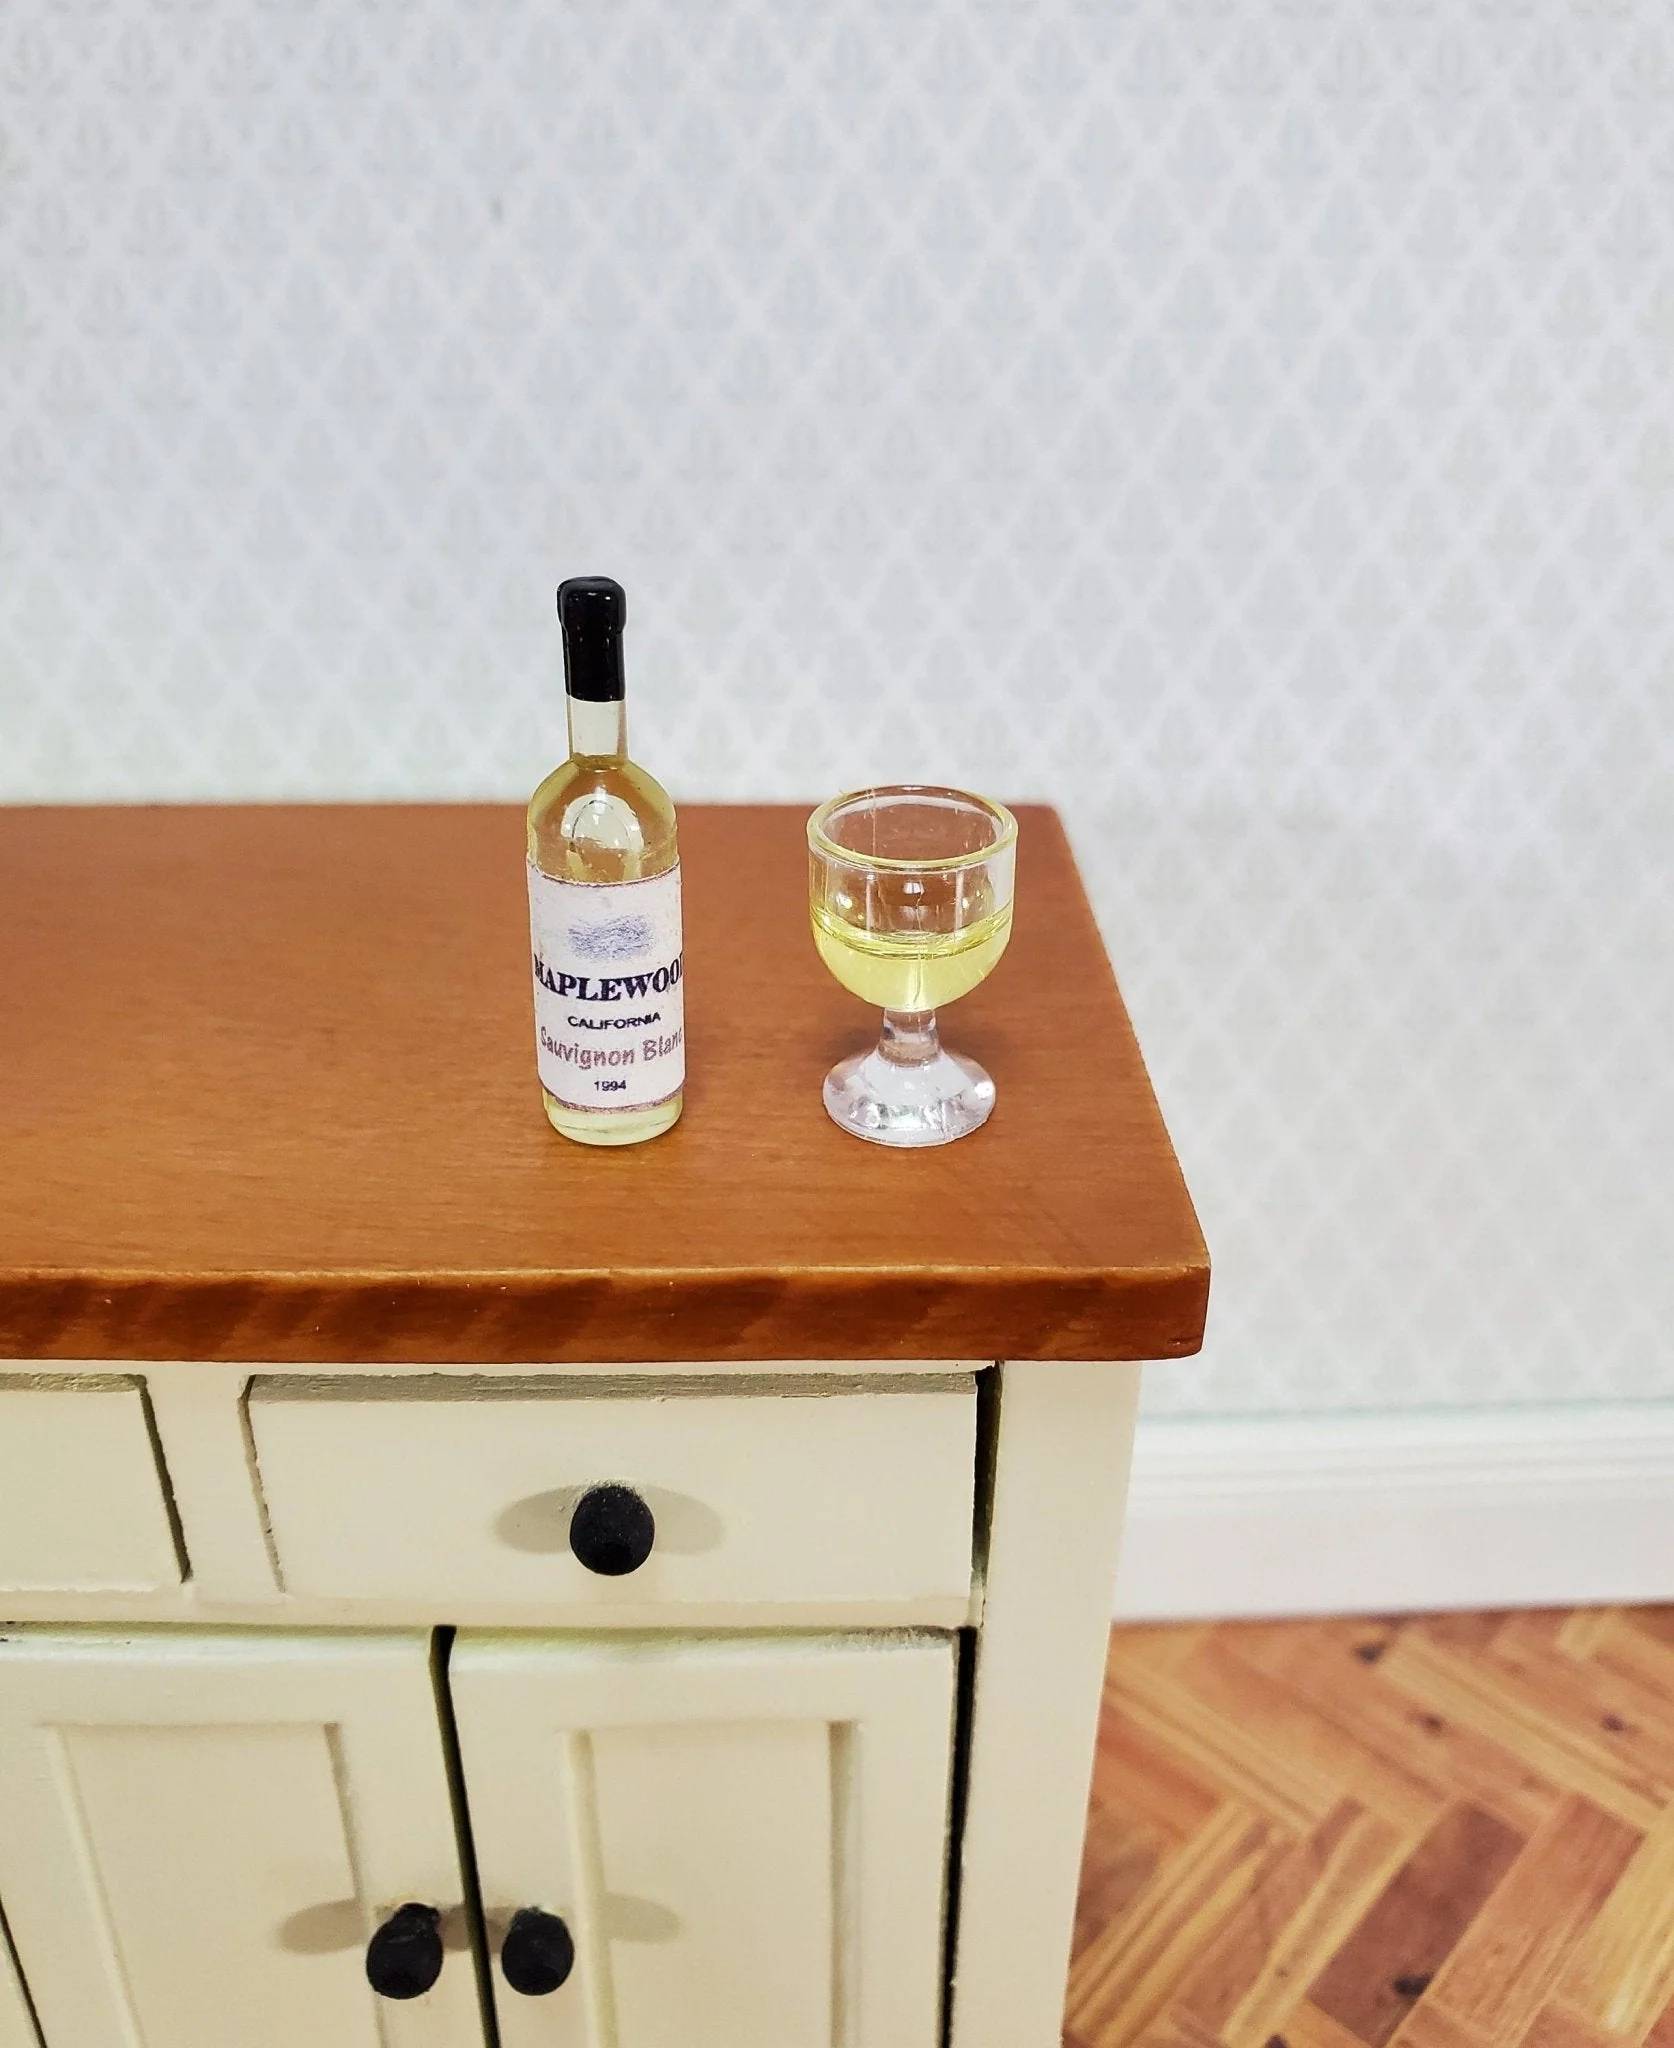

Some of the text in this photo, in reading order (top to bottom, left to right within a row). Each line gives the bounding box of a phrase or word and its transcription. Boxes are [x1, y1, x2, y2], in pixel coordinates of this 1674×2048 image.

[568, 1012, 661, 1030] CALIFORNIA
[540, 1026, 635, 1070] Sauvignon
[594, 1079, 627, 1092] 1994
